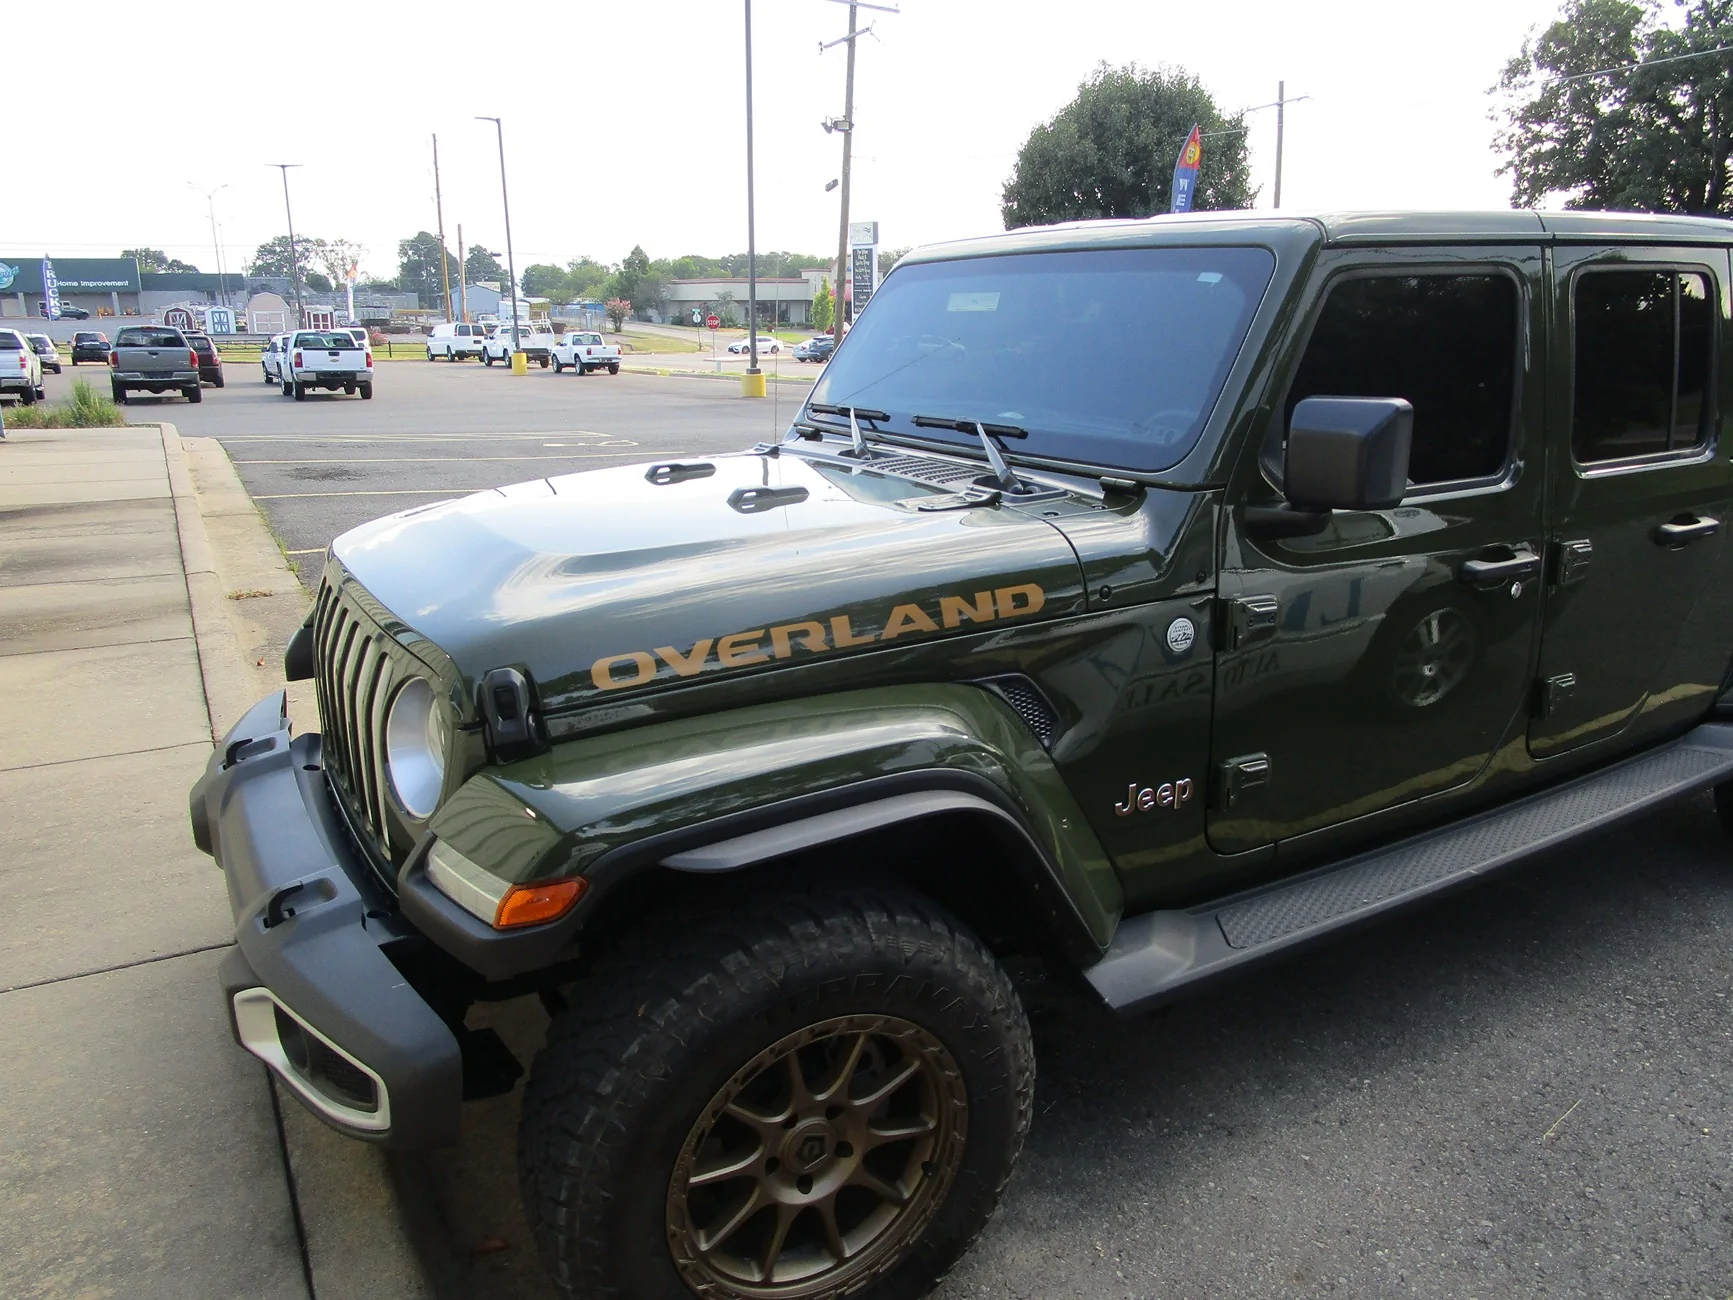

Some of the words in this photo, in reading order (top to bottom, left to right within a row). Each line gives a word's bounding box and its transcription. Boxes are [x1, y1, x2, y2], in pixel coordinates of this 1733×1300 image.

[1174, 178, 1189, 213] WE
[45, 260, 61, 316] TRUCKS
[80, 280, 129, 288] Improvement
[591, 583, 1045, 690] OVERLAND
[1114, 777, 1194, 817] Jeep
